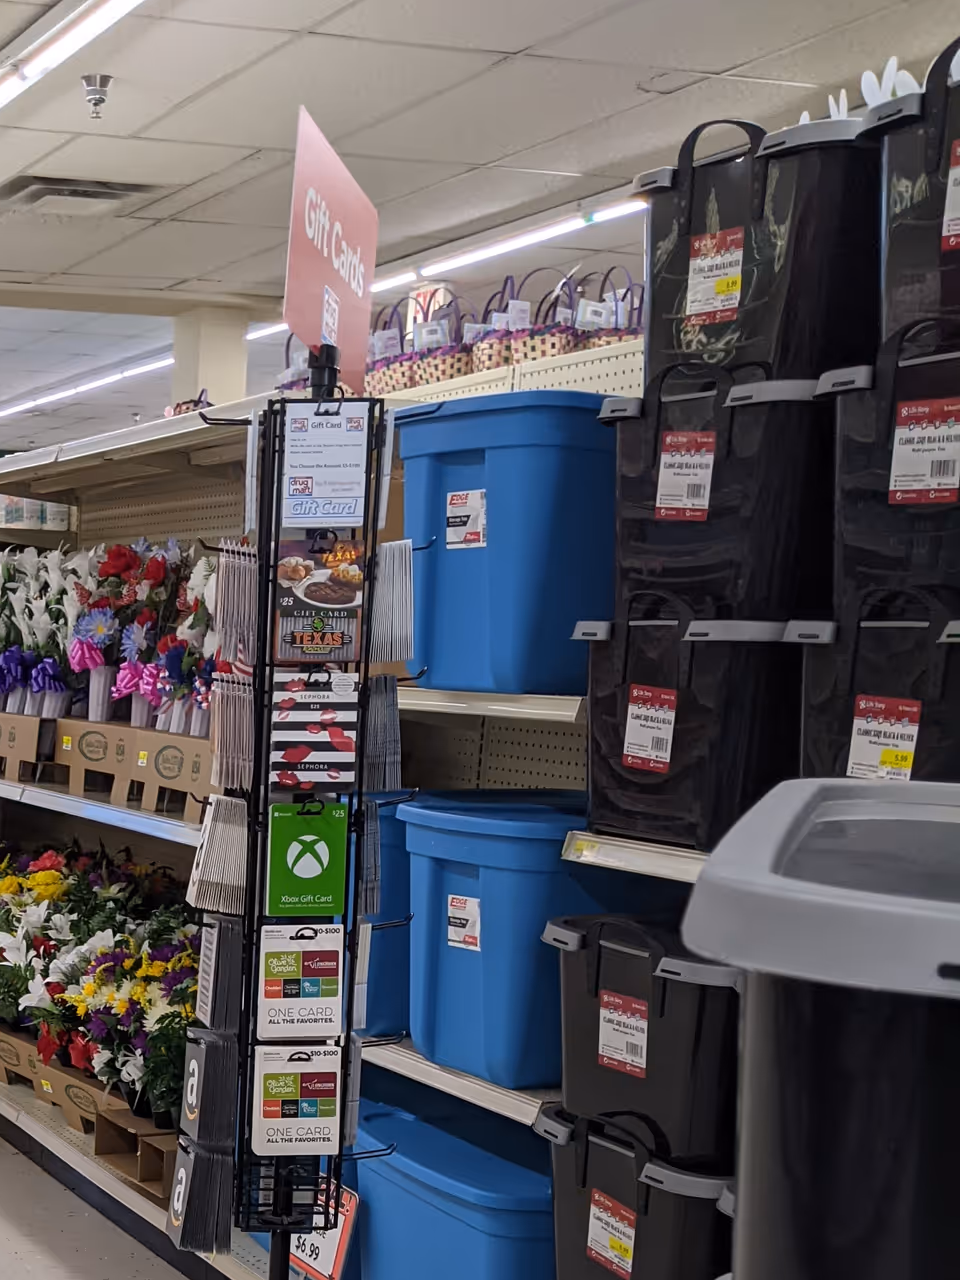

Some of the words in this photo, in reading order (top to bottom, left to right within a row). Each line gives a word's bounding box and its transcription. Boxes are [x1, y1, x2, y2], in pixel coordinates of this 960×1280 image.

[305, 187, 330, 257] Gift
[331, 221, 365, 298] Cards
[311, 421, 324, 429] Gift
[325, 421, 342, 429] Card
[290, 478, 309, 487] drug
[292, 486, 312, 494] mart
[449, 493, 469, 505] EDGE
[291, 499, 320, 516] Gift
[320, 499, 358, 515] Card
[280, 597, 294, 606] $25
[294, 632, 343, 645] TEXAS
[281, 895, 299, 903] Xbox
[450, 897, 468, 907] EDGE
[268, 957, 287, 966] Olive
[270, 965, 297, 974] Garden
[268, 1007, 294, 1018] ONE
[298, 1007, 335, 1017] CARD.
[266, 1079, 285, 1087] Olive
[269, 1086, 296, 1094] Garden
[266, 1127, 292, 1137] ONE
[296, 1126, 333, 1136] CARD.
[295, 1235, 320, 1261] $6.99
